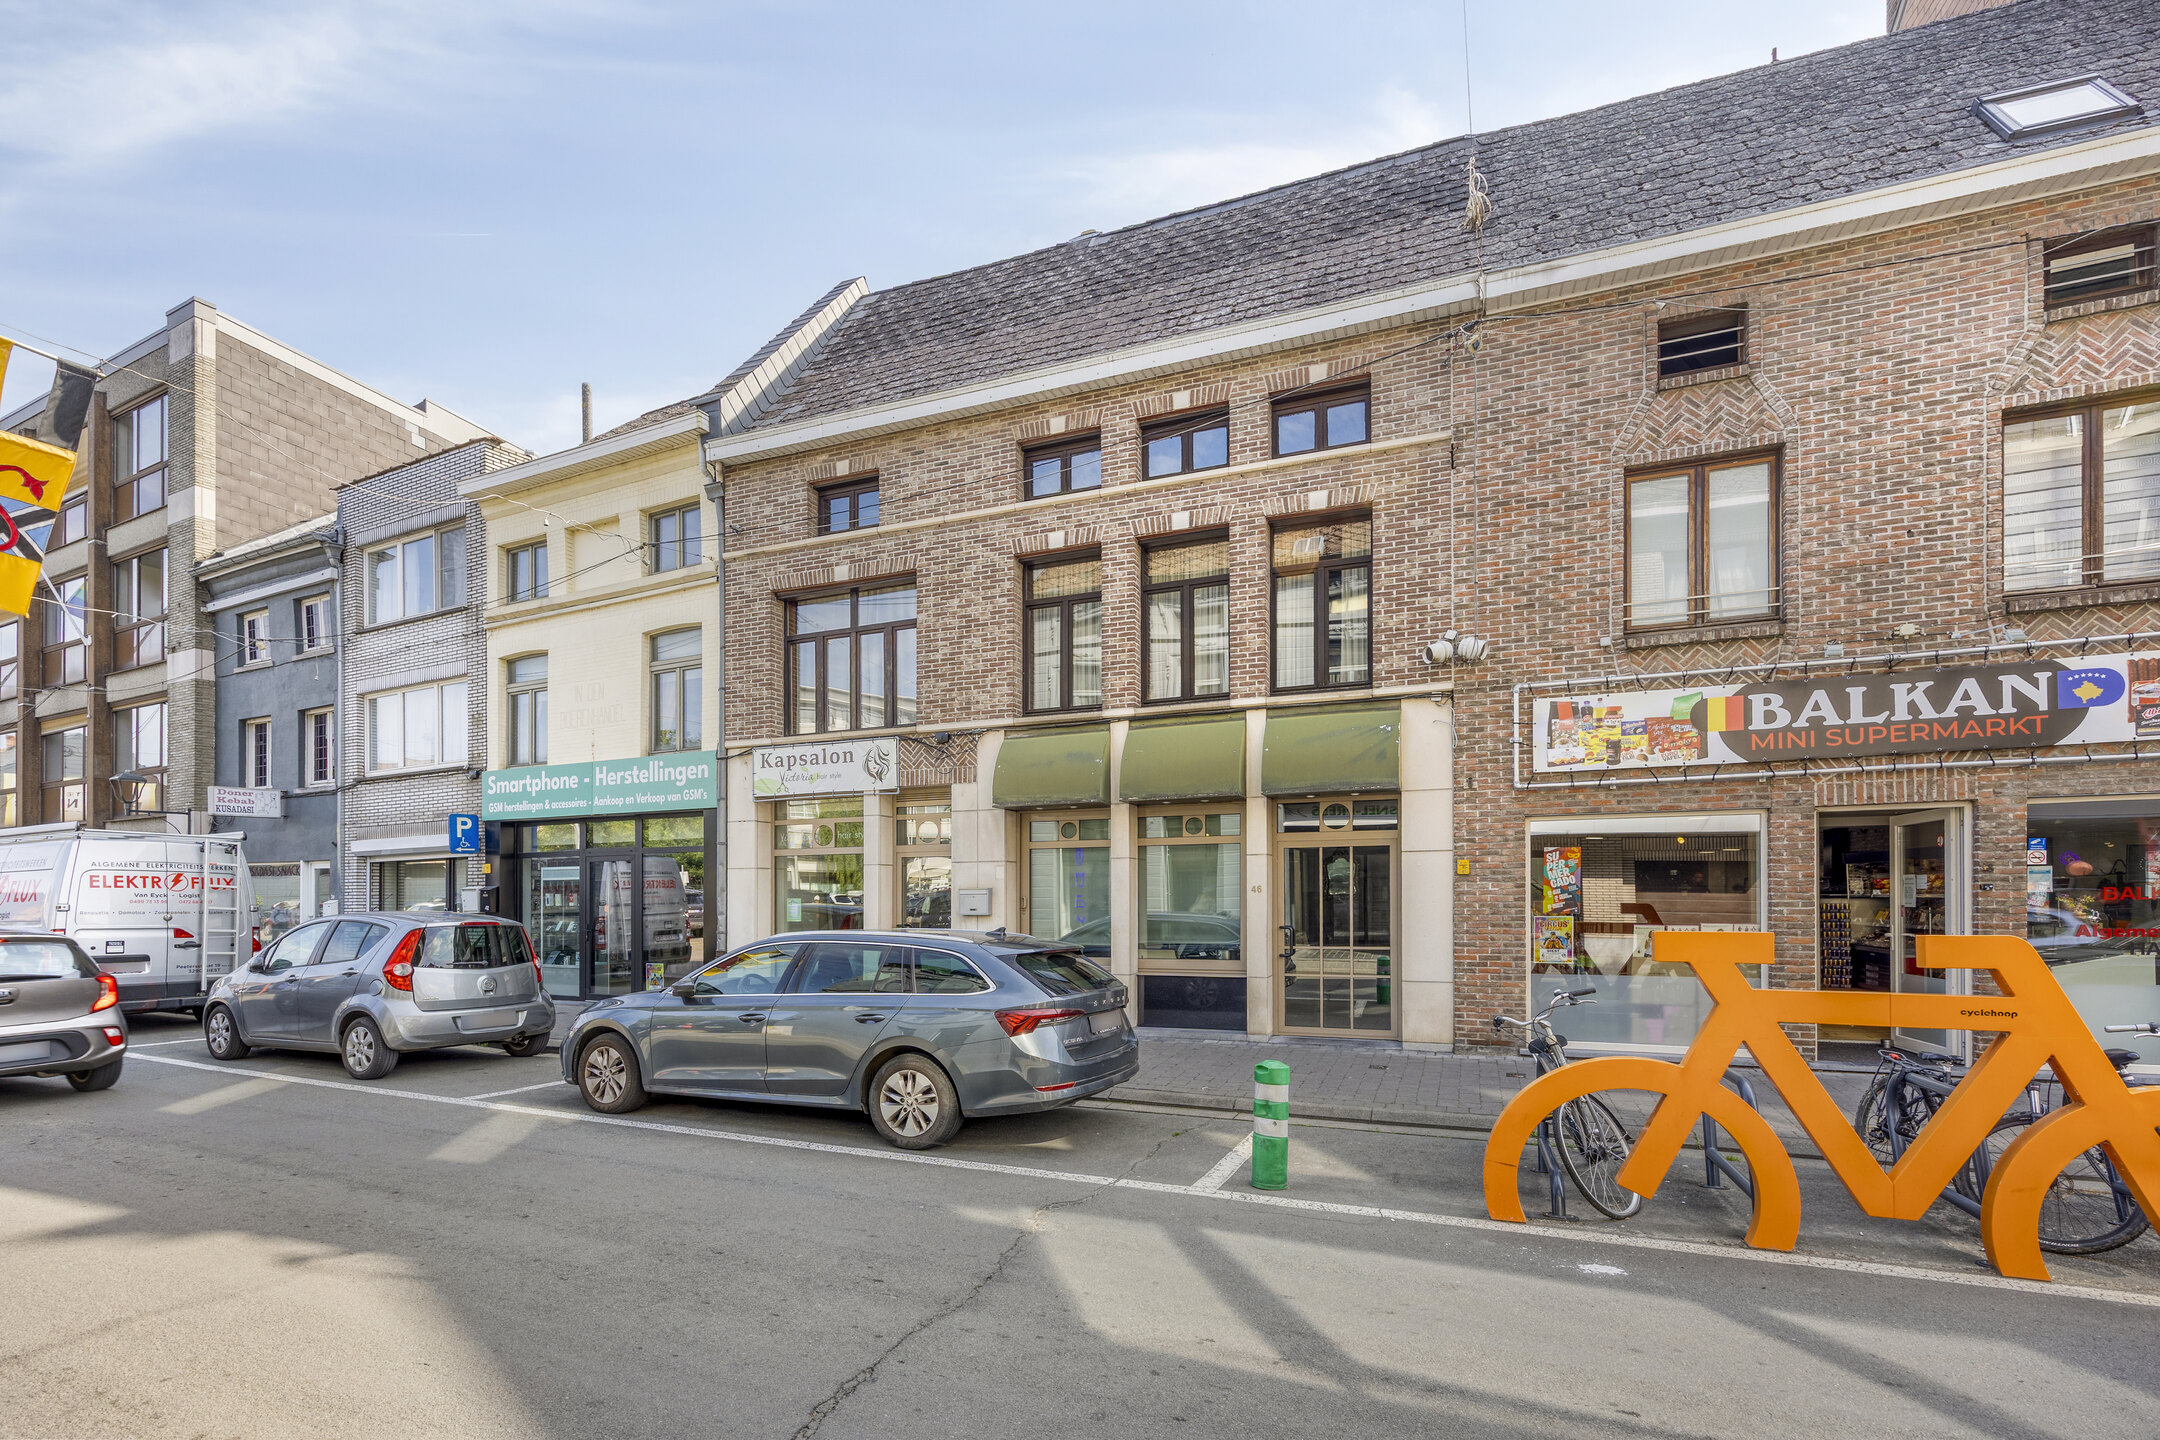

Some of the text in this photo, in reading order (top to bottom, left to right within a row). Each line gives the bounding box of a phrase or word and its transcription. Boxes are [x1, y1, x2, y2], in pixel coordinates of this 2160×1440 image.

[1748, 671, 2052, 730] BALKAN
[1751, 715, 2049, 751] MINI SUPERMARKT
[760, 748, 855, 771] Kapsalon
[487, 771, 579, 797] Smartphone
[595, 761, 709, 786] Herstellingen
[217, 789, 254, 797] Doner
[217, 796, 255, 805] Kebab
[488, 802, 503, 813] GSM
[504, 800, 543, 813] herstellingen
[544, 799, 551, 810] &
[551, 797, 588, 809] accessoires
[593, 795, 624, 807] Aankoop
[625, 796, 634, 804] en
[636, 792, 665, 805] Verkoop
[667, 793, 682, 802] van
[683, 788, 708, 801] GSM's
[215, 804, 255, 814] KUSADASI
[456, 817, 473, 838] P
[1546, 851, 1560, 862] SU
[1546, 859, 1566, 871] PER
[1547, 867, 1571, 880] MER
[1550, 875, 1576, 888] CADO
[1250, 885, 1262, 894] 46
[1540, 920, 1568, 928] CIRCUS
[1960, 1009, 2018, 1019] cyclehoop
